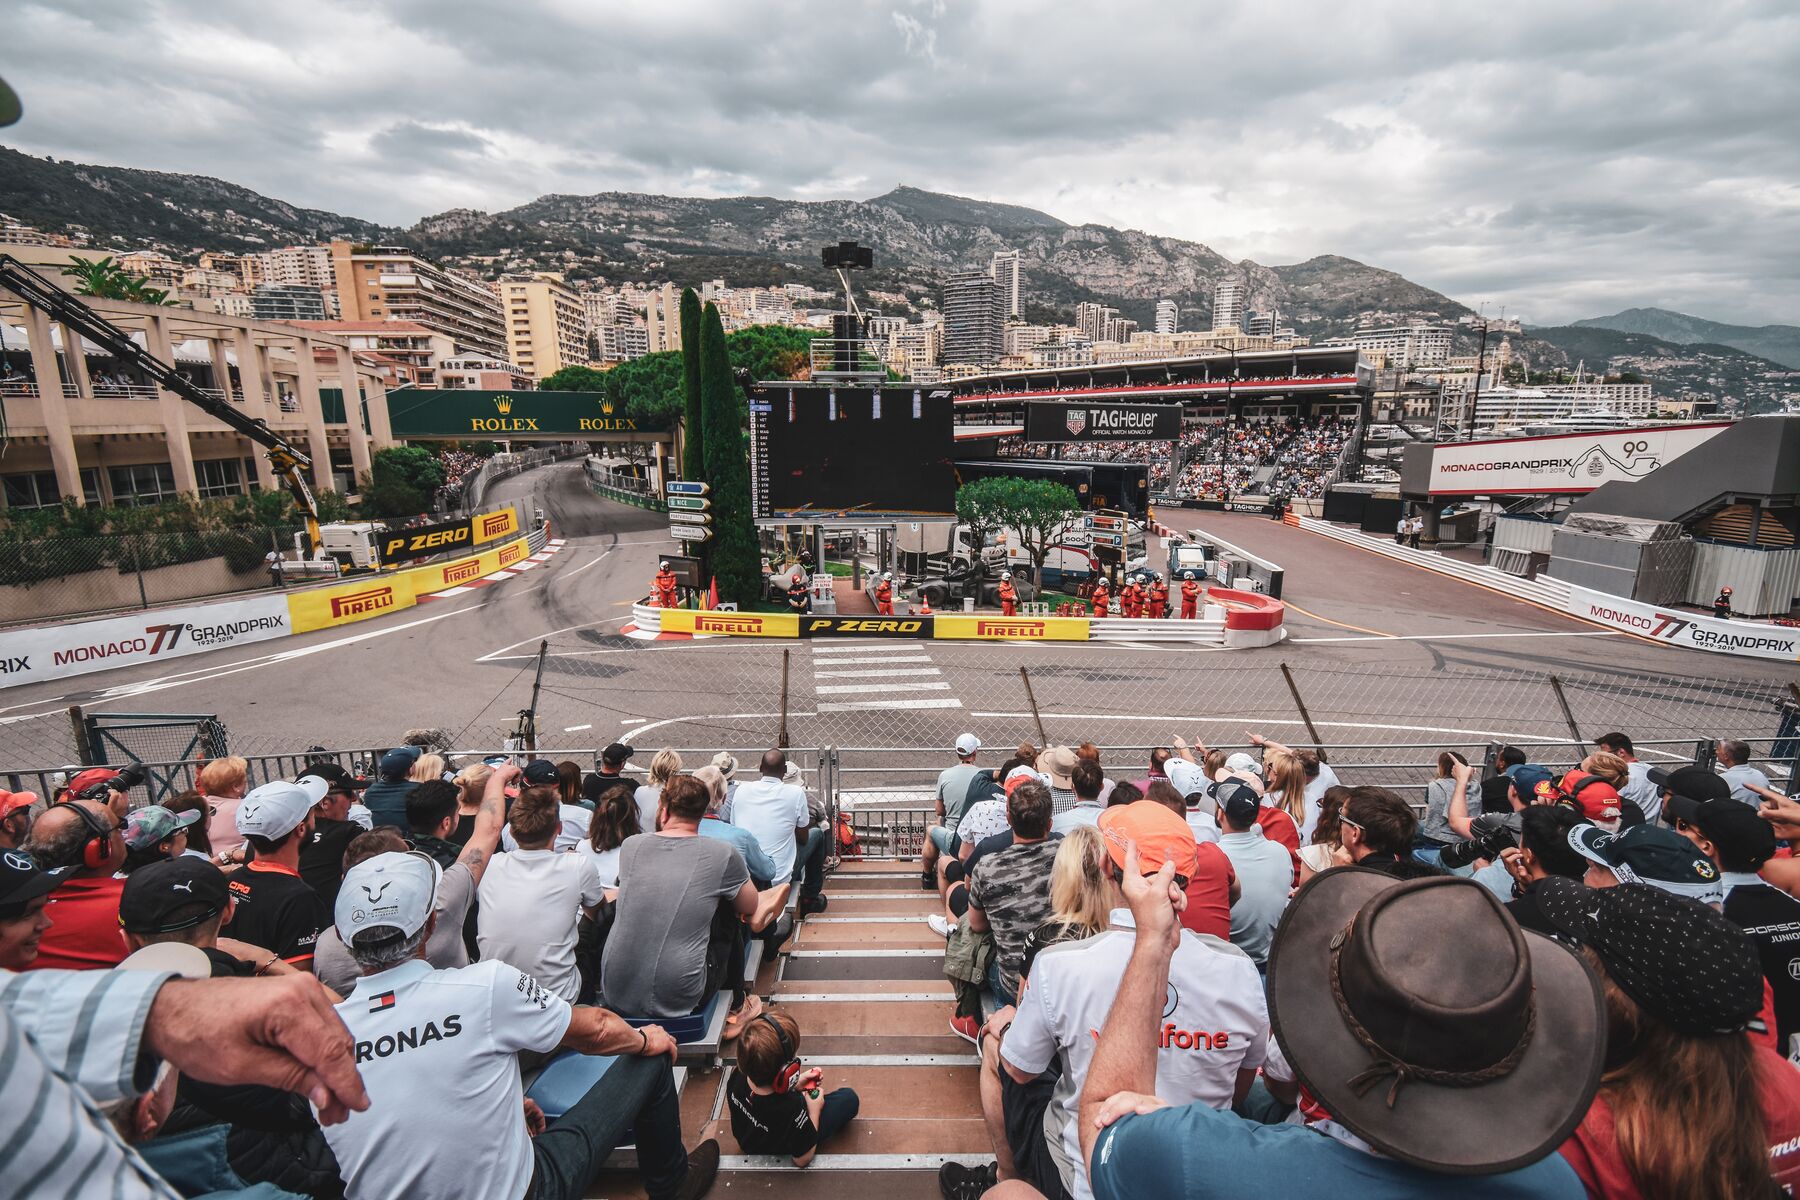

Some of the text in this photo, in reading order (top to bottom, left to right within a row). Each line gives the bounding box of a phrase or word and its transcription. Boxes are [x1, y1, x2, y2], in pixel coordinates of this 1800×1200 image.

[470, 418, 540, 431] ROLEX
[579, 418, 638, 430] ROLEX
[1069, 411, 1084, 420] TAG
[1623, 440, 1648, 459] 90
[483, 513, 510, 537] PIRELLI
[386, 527, 469, 556] P ZERO
[498, 544, 520, 565] PIRELLI
[443, 559, 480, 584] PIRELLI
[330, 587, 393, 618] PIRELLI
[695, 615, 763, 633] PIRELLI
[809, 620, 922, 632] P ZERO
[977, 621, 1046, 637] PIRELLI
[1590, 605, 1651, 630] MONACO
[1692, 629, 1795, 653] GRANDPRIX
[53, 638, 147, 666] MONACO
[191, 614, 284, 642] GRANDPRIX
[197, 635, 234, 646] 1929-2019
[1695, 641, 1736, 651] 1929-2019
[1742, 921, 1800, 935] PORSC
[1771, 932, 1800, 943] JUNIO
[356, 1014, 463, 1064] RONAS
